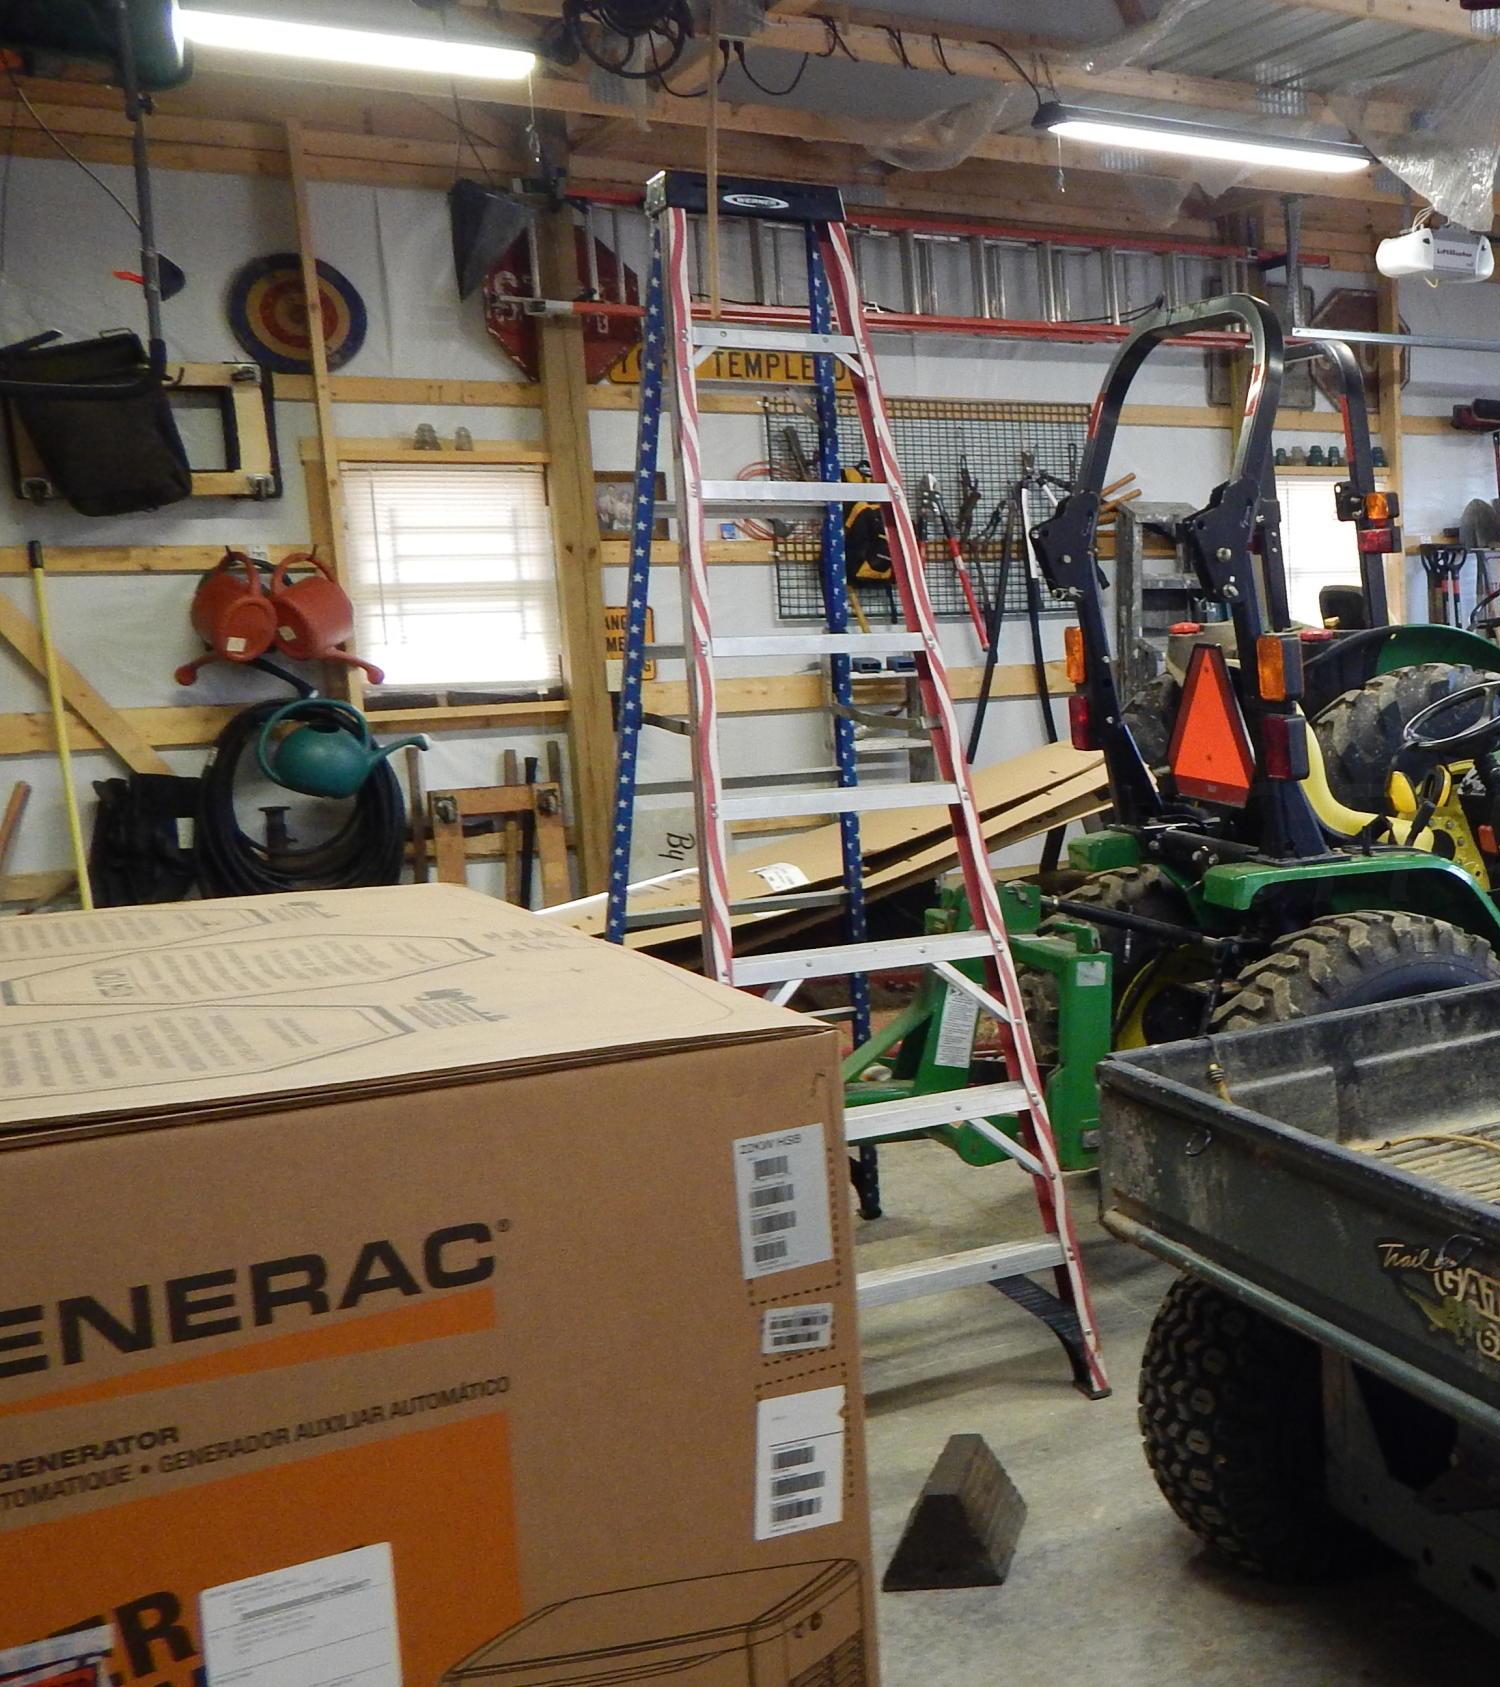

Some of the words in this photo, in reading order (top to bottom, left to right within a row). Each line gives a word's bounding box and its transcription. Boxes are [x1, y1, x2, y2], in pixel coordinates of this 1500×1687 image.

[712, 350, 815, 380] TEMPLE
[1377, 1242, 1446, 1272] Trail
[159, 1427, 291, 1476] GENERADOR
[292, 1404, 387, 1443] AUXILIAR
